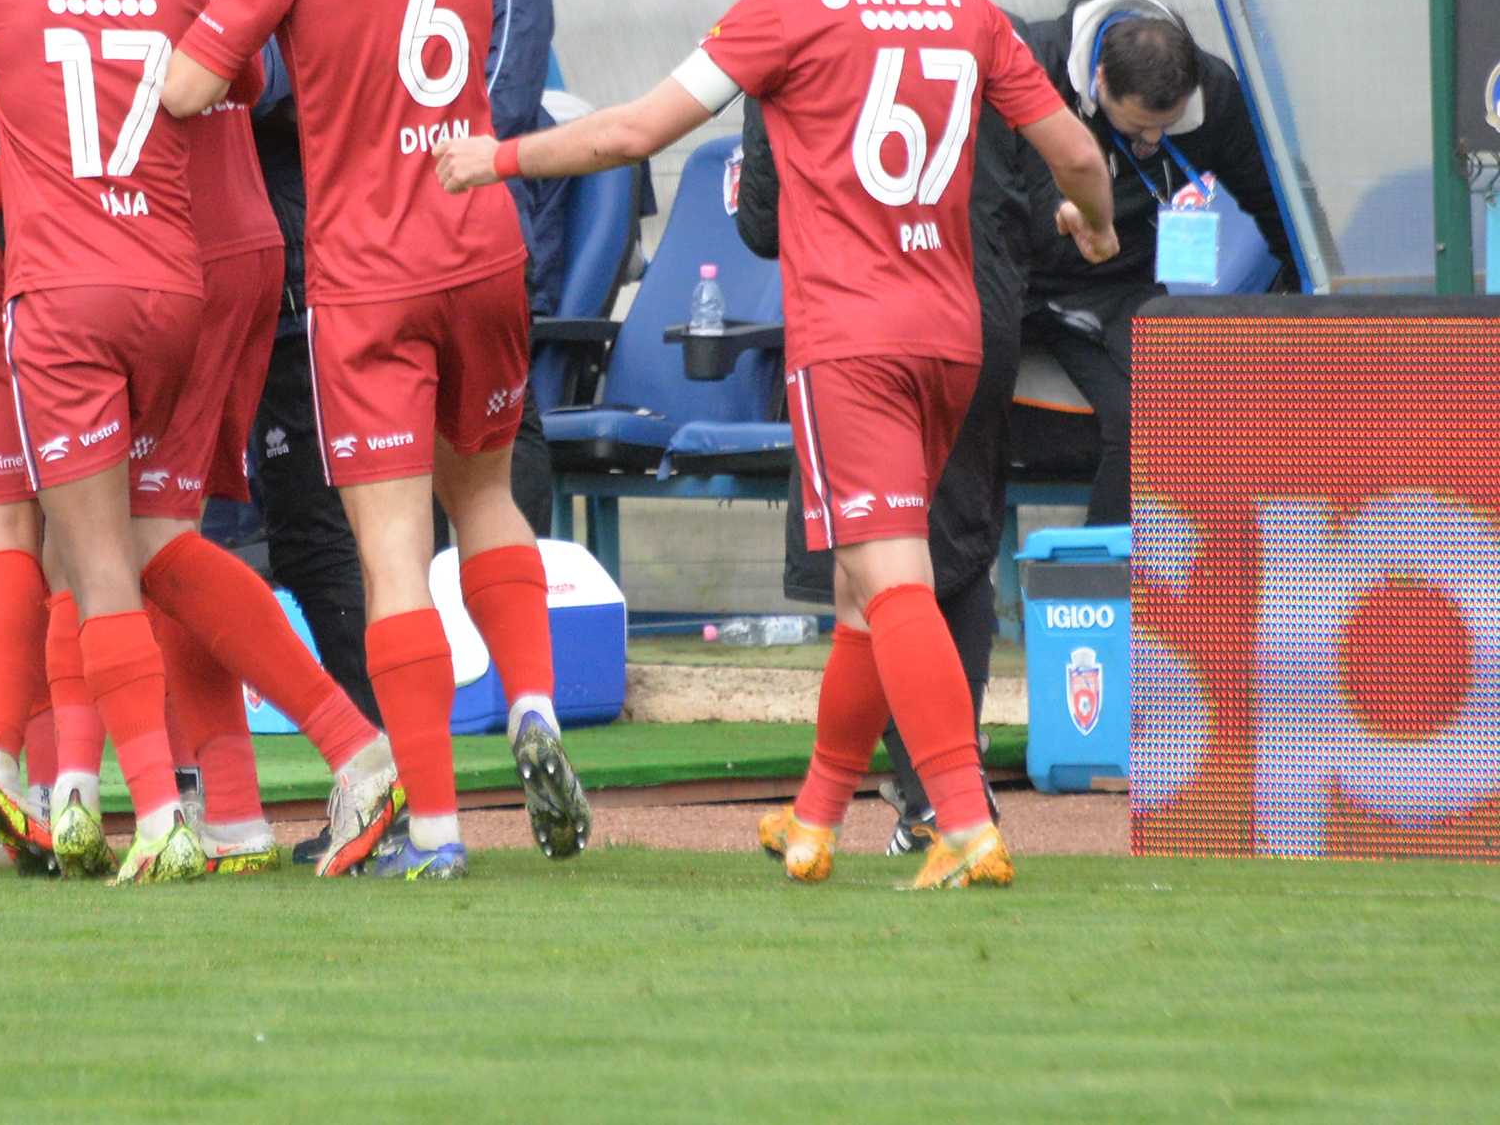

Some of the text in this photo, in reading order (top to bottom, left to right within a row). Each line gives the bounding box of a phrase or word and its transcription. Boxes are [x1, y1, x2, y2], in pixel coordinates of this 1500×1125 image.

[44, 28, 173, 178] 17
[852, 48, 978, 207] 67
[79, 422, 121, 447] Vestra
[366, 432, 414, 452] Vestra
[886, 495, 925, 509] Vestra
[1046, 604, 1115, 629] IGLOO
